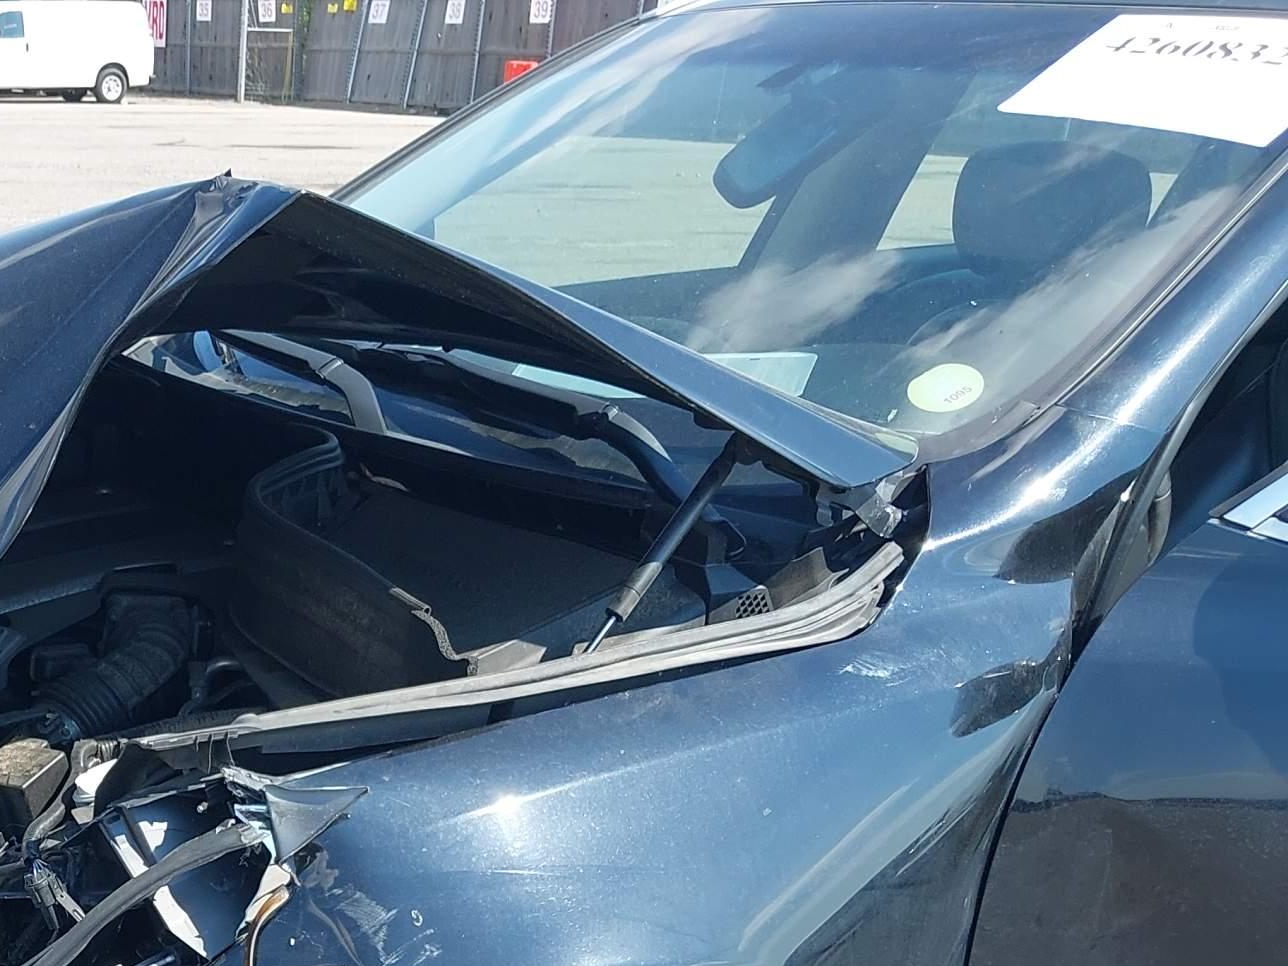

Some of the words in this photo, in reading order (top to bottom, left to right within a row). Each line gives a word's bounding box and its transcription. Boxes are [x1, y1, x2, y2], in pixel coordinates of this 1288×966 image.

[261, 2, 273, 18] 36
[373, 2, 387, 18] 37
[448, 1, 462, 19] 38
[533, 0, 549, 18] 39
